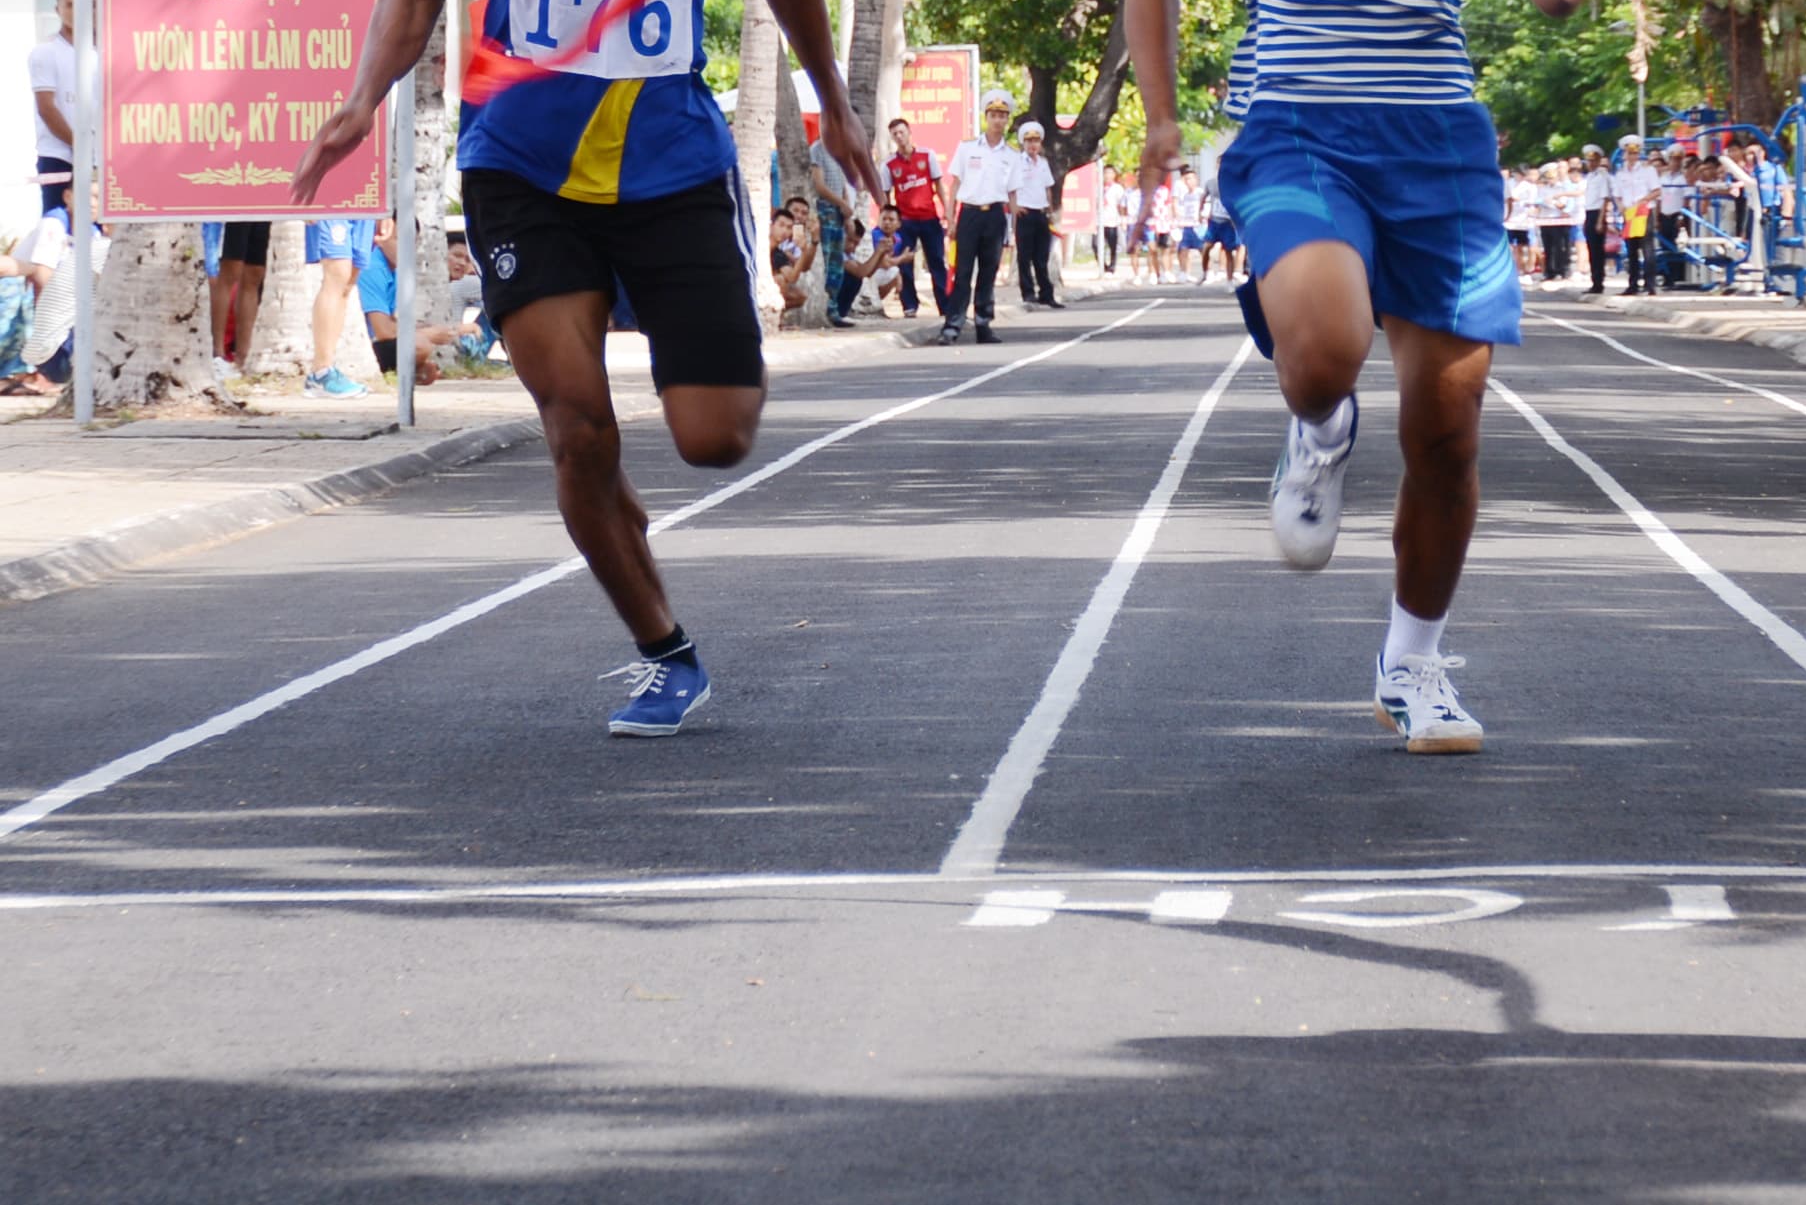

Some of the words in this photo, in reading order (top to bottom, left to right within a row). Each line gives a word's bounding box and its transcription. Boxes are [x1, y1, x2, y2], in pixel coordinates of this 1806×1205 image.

[133, 24, 193, 71] VƯƠN
[201, 19, 245, 70] LÊN
[252, 19, 300, 70] LÀM
[306, 13, 352, 70] CHỦ
[120, 102, 182, 144] KHOA
[189, 102, 241, 152] HỌC,
[248, 92, 281, 142] KỸ
